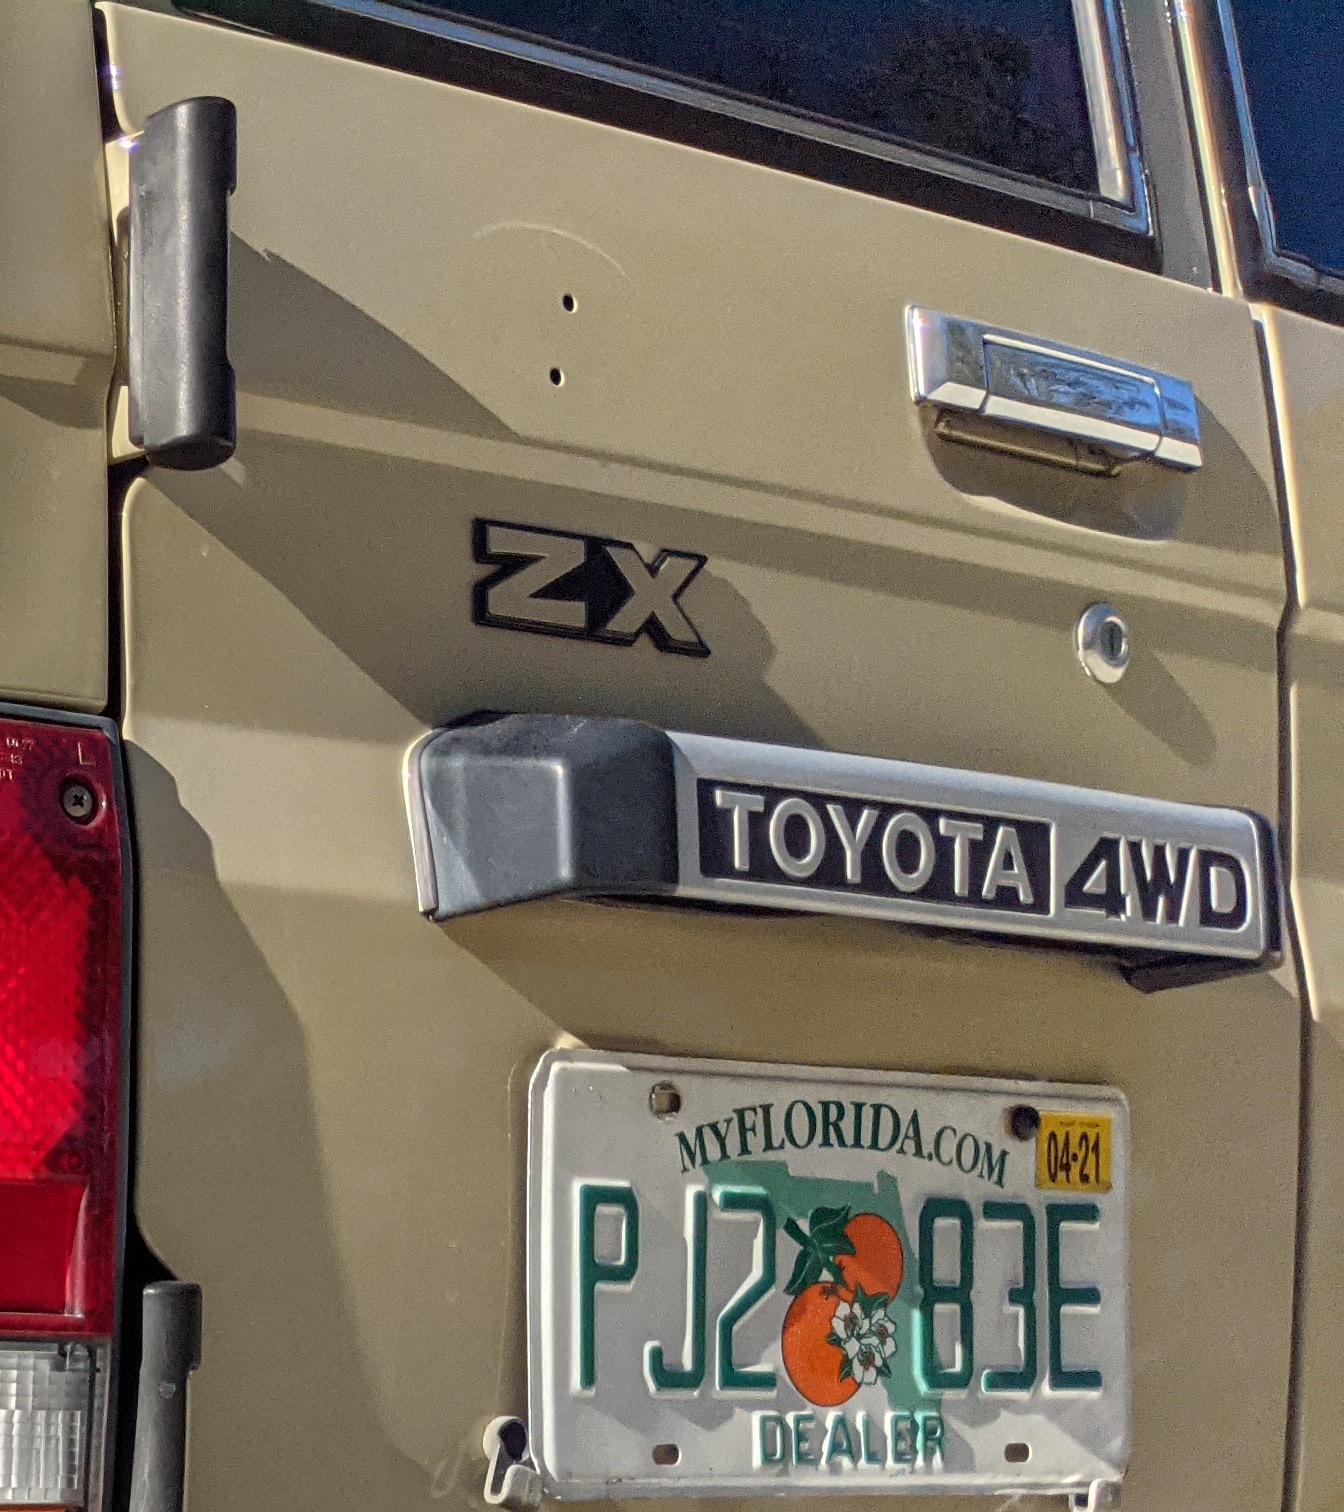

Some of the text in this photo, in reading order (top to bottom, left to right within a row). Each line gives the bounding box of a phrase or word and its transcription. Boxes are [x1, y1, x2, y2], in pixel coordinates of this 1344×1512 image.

[471, 516, 711, 657] ZX
[715, 790, 1249, 932] TOYOTA 4WD
[675, 1099, 1010, 1189] MYFLORIDA.COM
[576, 1182, 1103, 1396] PJ2 83E
[757, 1411, 946, 1469] DEALER
